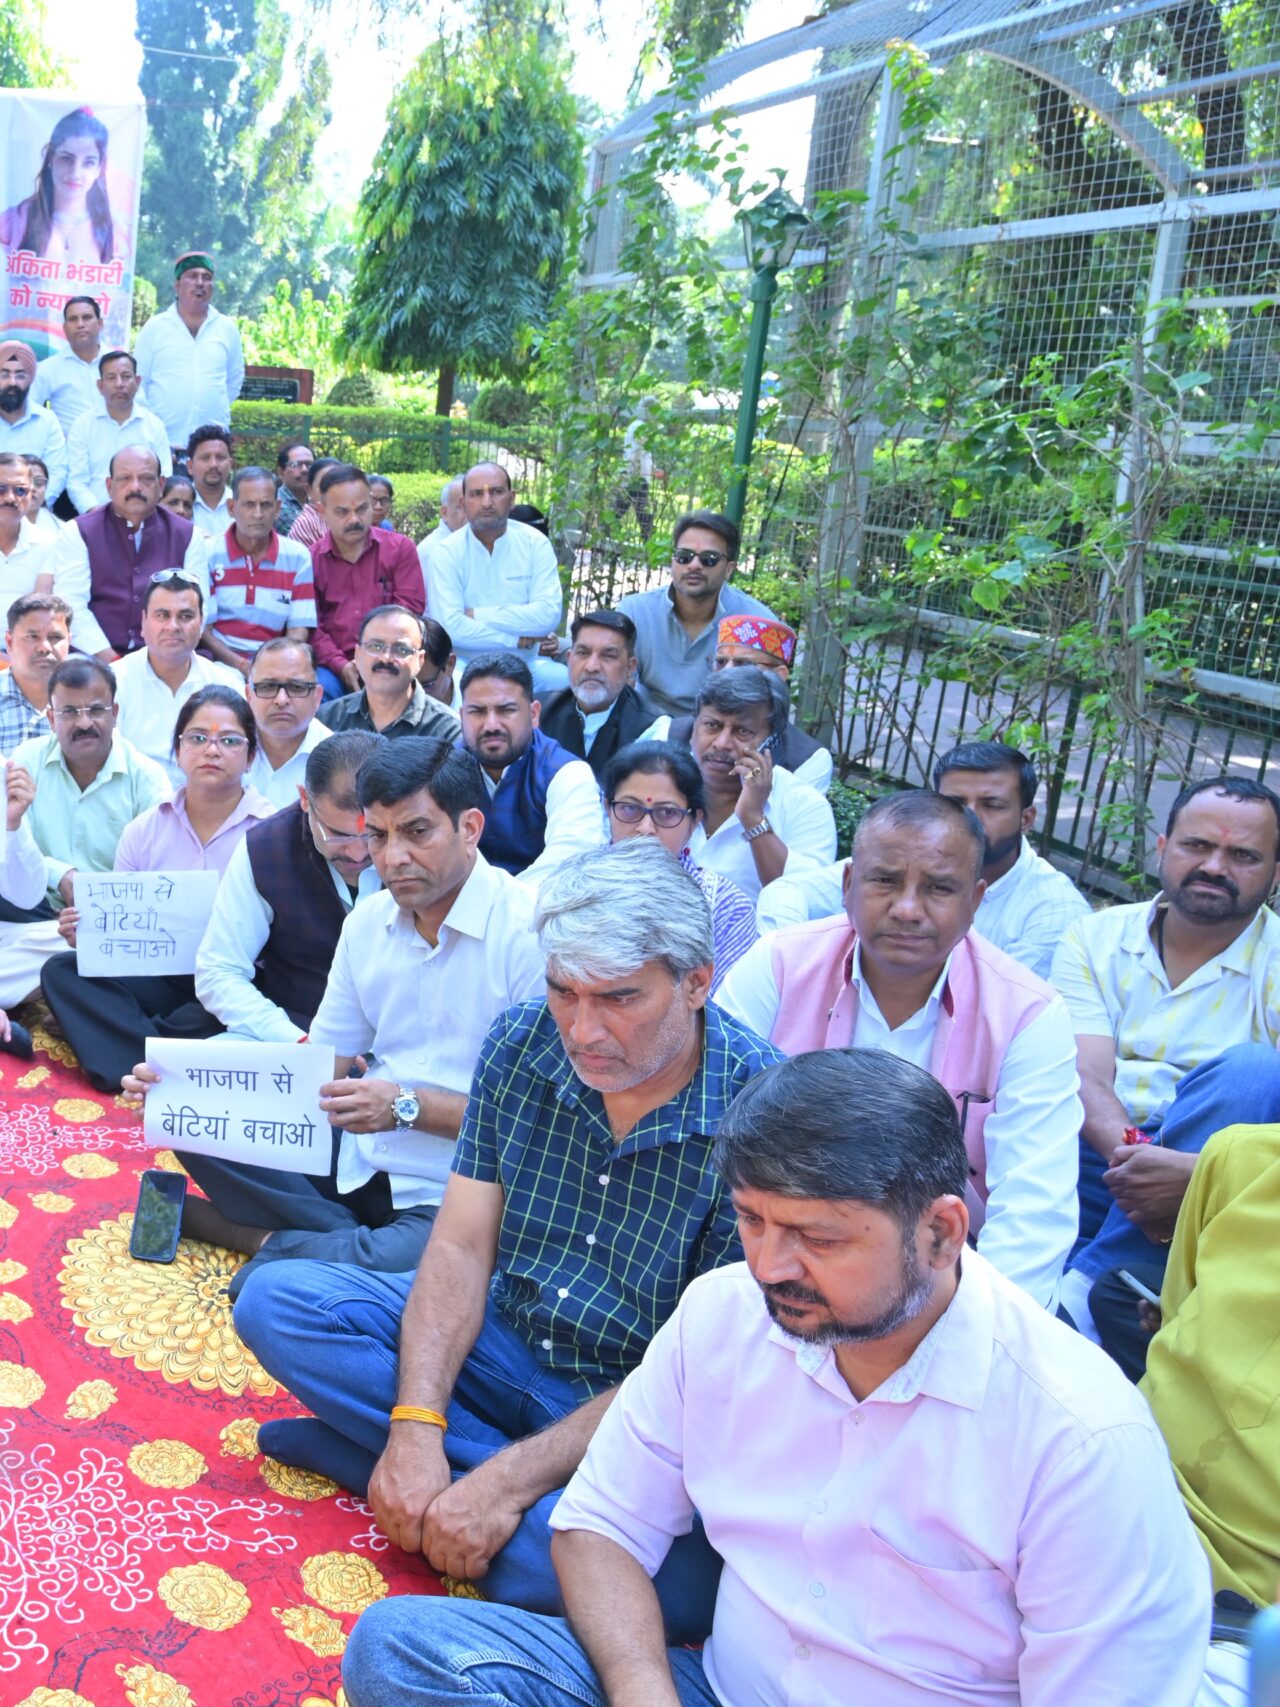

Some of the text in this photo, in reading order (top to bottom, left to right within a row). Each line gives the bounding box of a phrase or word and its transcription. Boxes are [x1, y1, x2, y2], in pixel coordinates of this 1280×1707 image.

[5, 251, 124, 285] अंकिता भंडारी
[10, 283, 32, 308] को
[88, 875, 176, 902] भाजपा से
[99, 927, 176, 959] बचाओ
[185, 1064, 294, 1094] भाजपा से
[161, 1103, 316, 1148] बेटियां बचाओ
